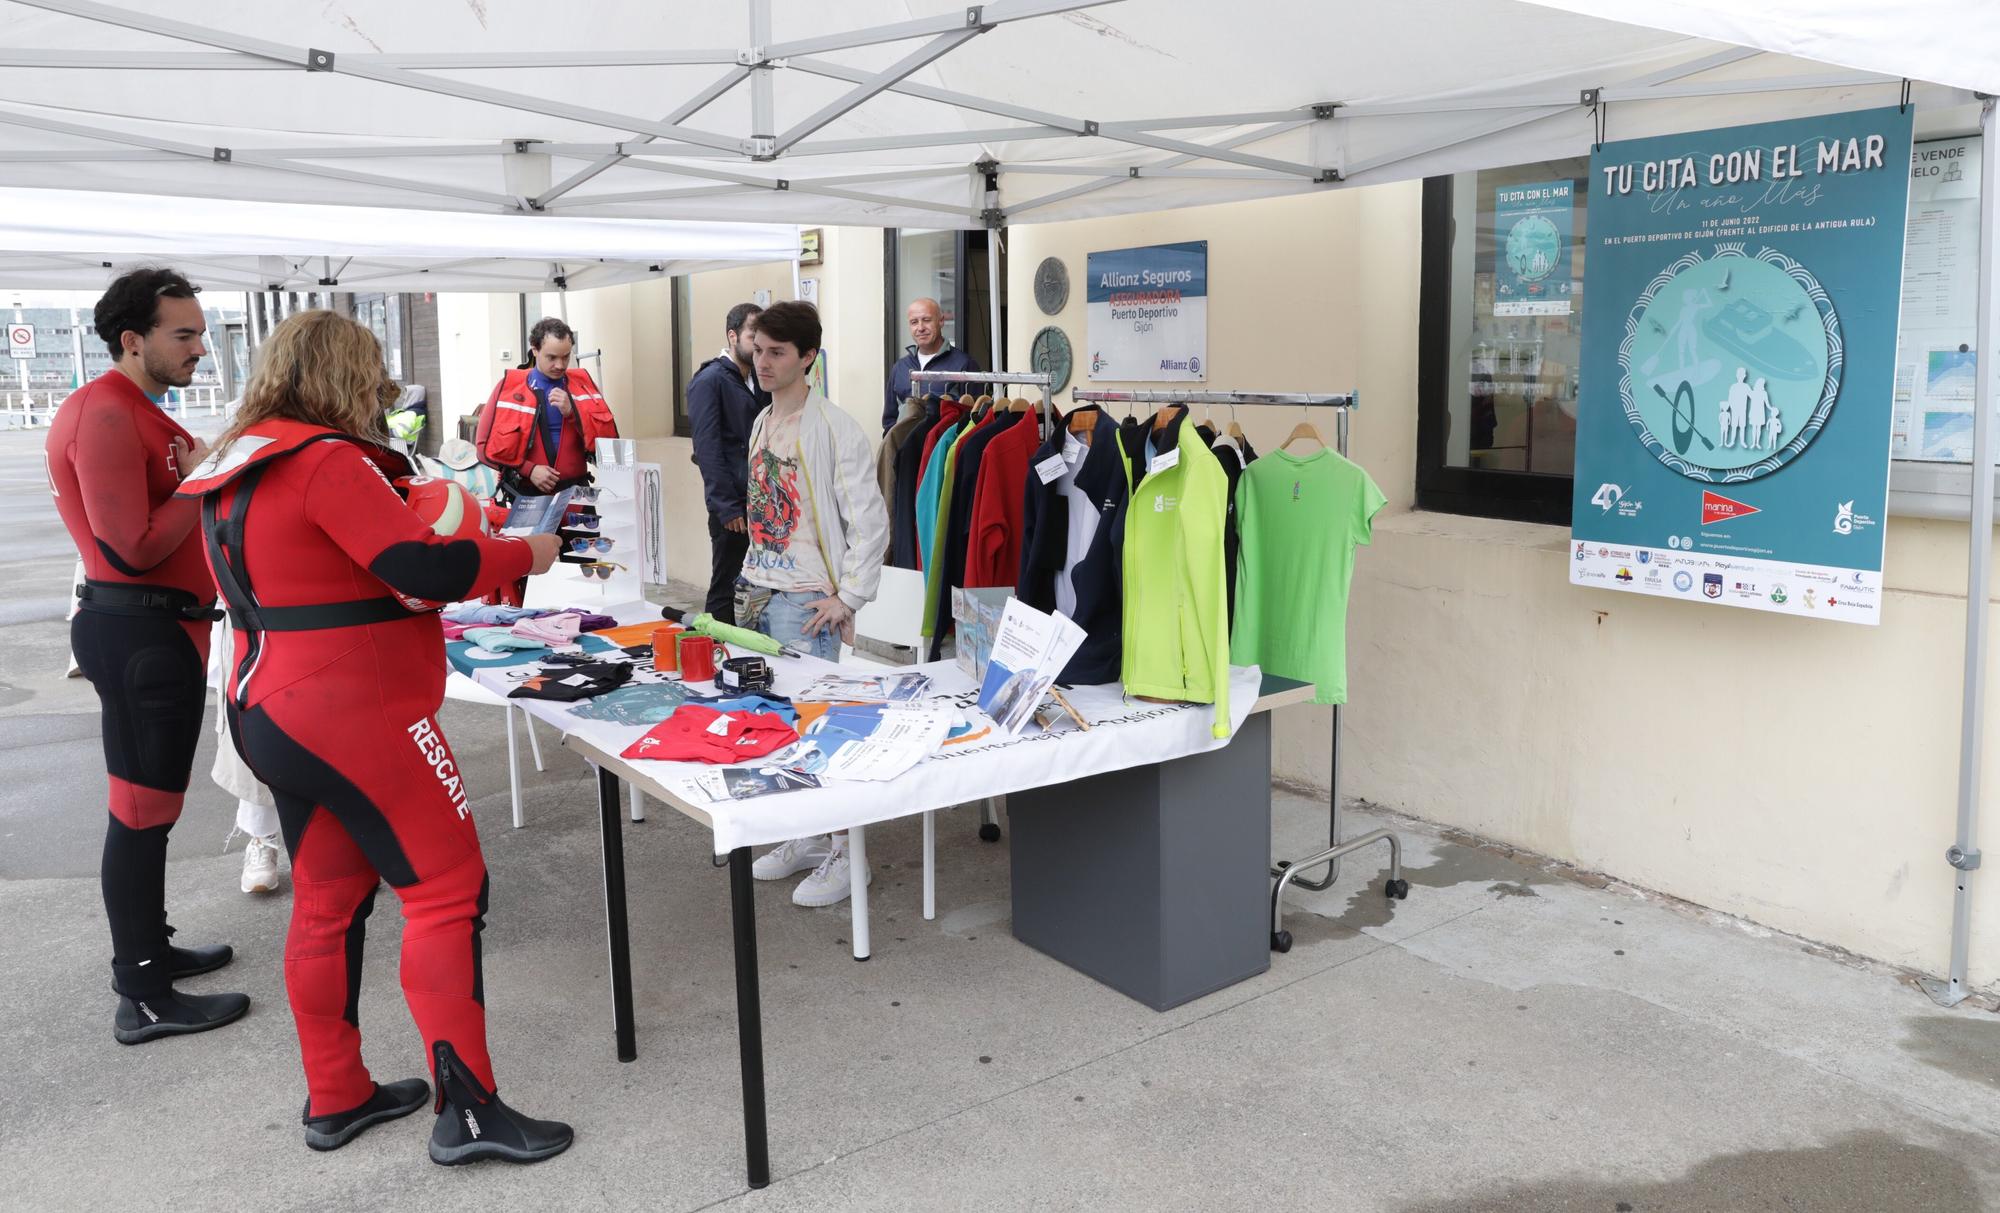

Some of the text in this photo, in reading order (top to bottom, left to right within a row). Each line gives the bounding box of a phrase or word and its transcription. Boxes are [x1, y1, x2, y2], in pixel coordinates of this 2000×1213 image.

[1921, 147, 1965, 161] VENDE
[1603, 134, 1885, 195] TU CITA CON EL MAR
[1499, 192, 1509, 203] TU
[1510, 191, 1525, 202] CITA
[1526, 189, 1541, 200] CON
[1542, 188, 1550, 199] EL
[1552, 186, 1569, 198] MAR
[1604, 216, 1876, 245] EN EL PUERTO DEPORTIVO DE GIJÓN (FRENTE AL EDIFICIO DE LA ANTIGUA RULA)
[1701, 216, 1760, 228] 11 DE JUNIO 2022
[1100, 269, 1192, 288] Allianz Seguros
[1109, 288, 1182, 307] ASEGURADORA
[1111, 306, 1178, 320] Puerto Deportivo
[1160, 359, 1188, 370] Allianz
[1704, 503, 1734, 512] marina
[407, 717, 469, 820] RESCATE
